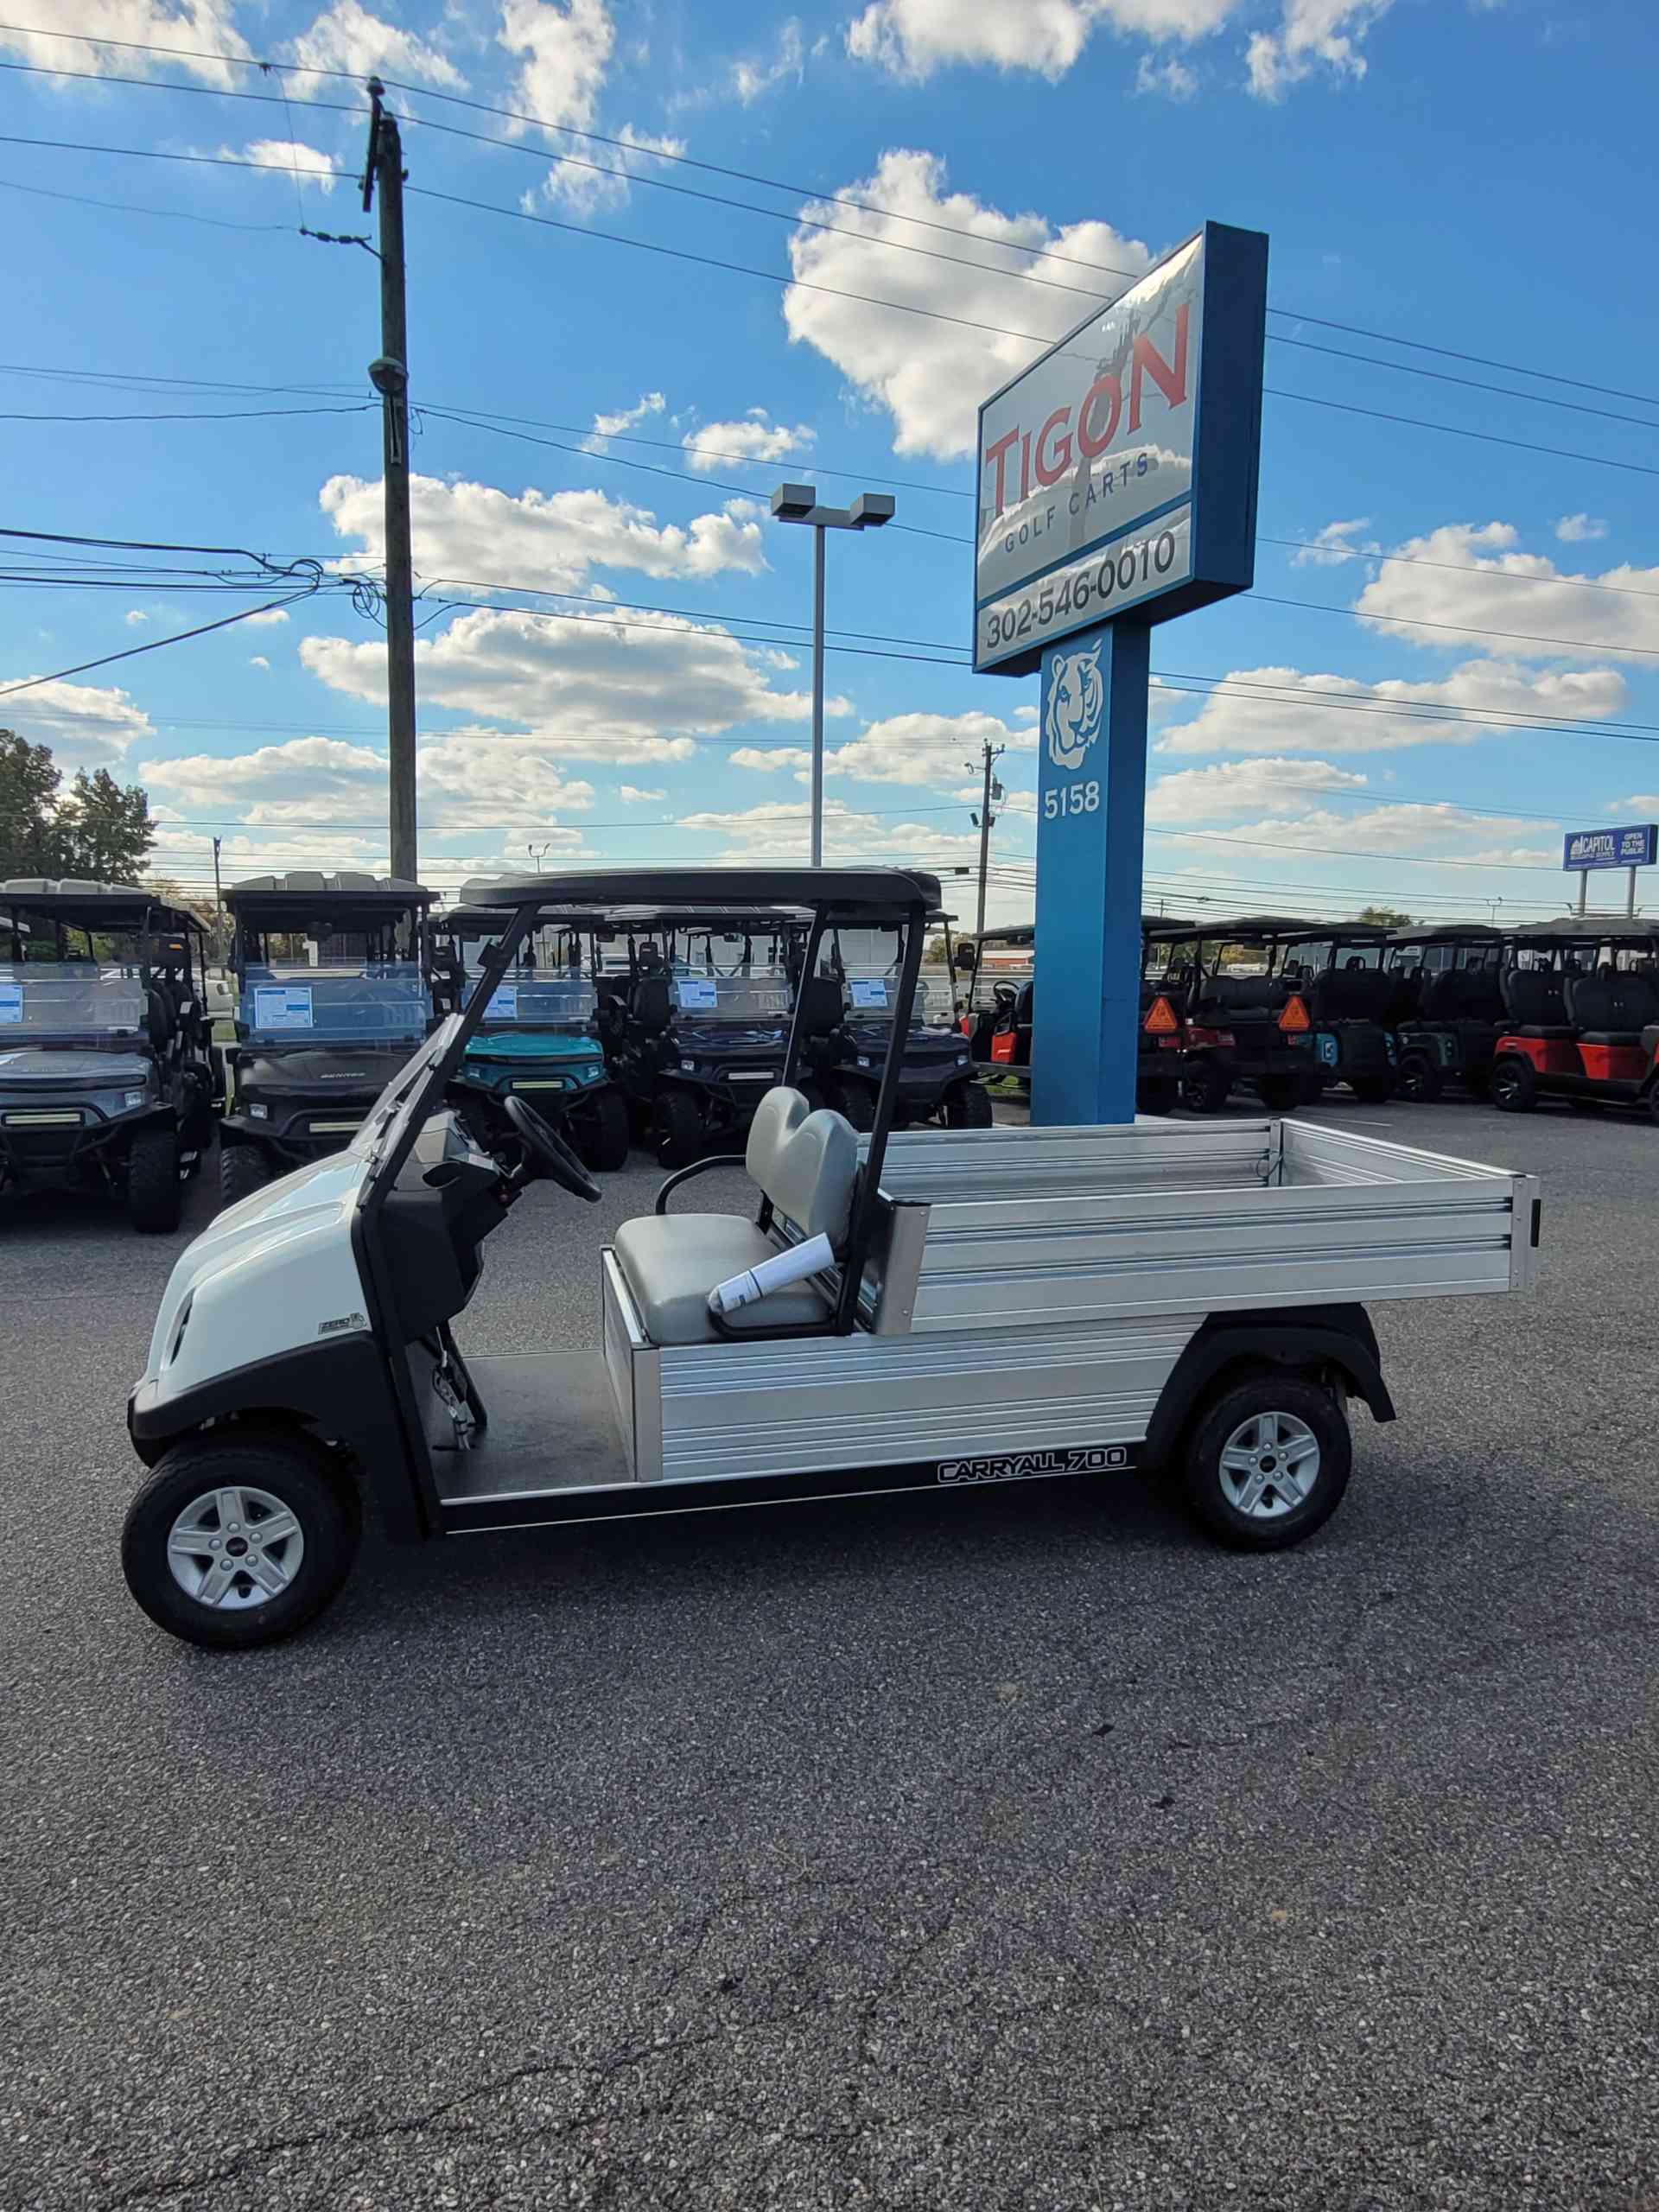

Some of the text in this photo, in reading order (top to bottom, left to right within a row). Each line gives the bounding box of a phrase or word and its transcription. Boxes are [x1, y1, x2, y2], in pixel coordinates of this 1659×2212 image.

[985, 303, 1188, 515] TIGON
[1004, 451, 1150, 554] GOLF CARTS
[987, 529, 1175, 650] 302-546-0010
[1043, 780, 1101, 820] 5158
[1583, 836, 1615, 854] CAPITOL
[938, 1446, 1127, 1483] CARRYALL 700
